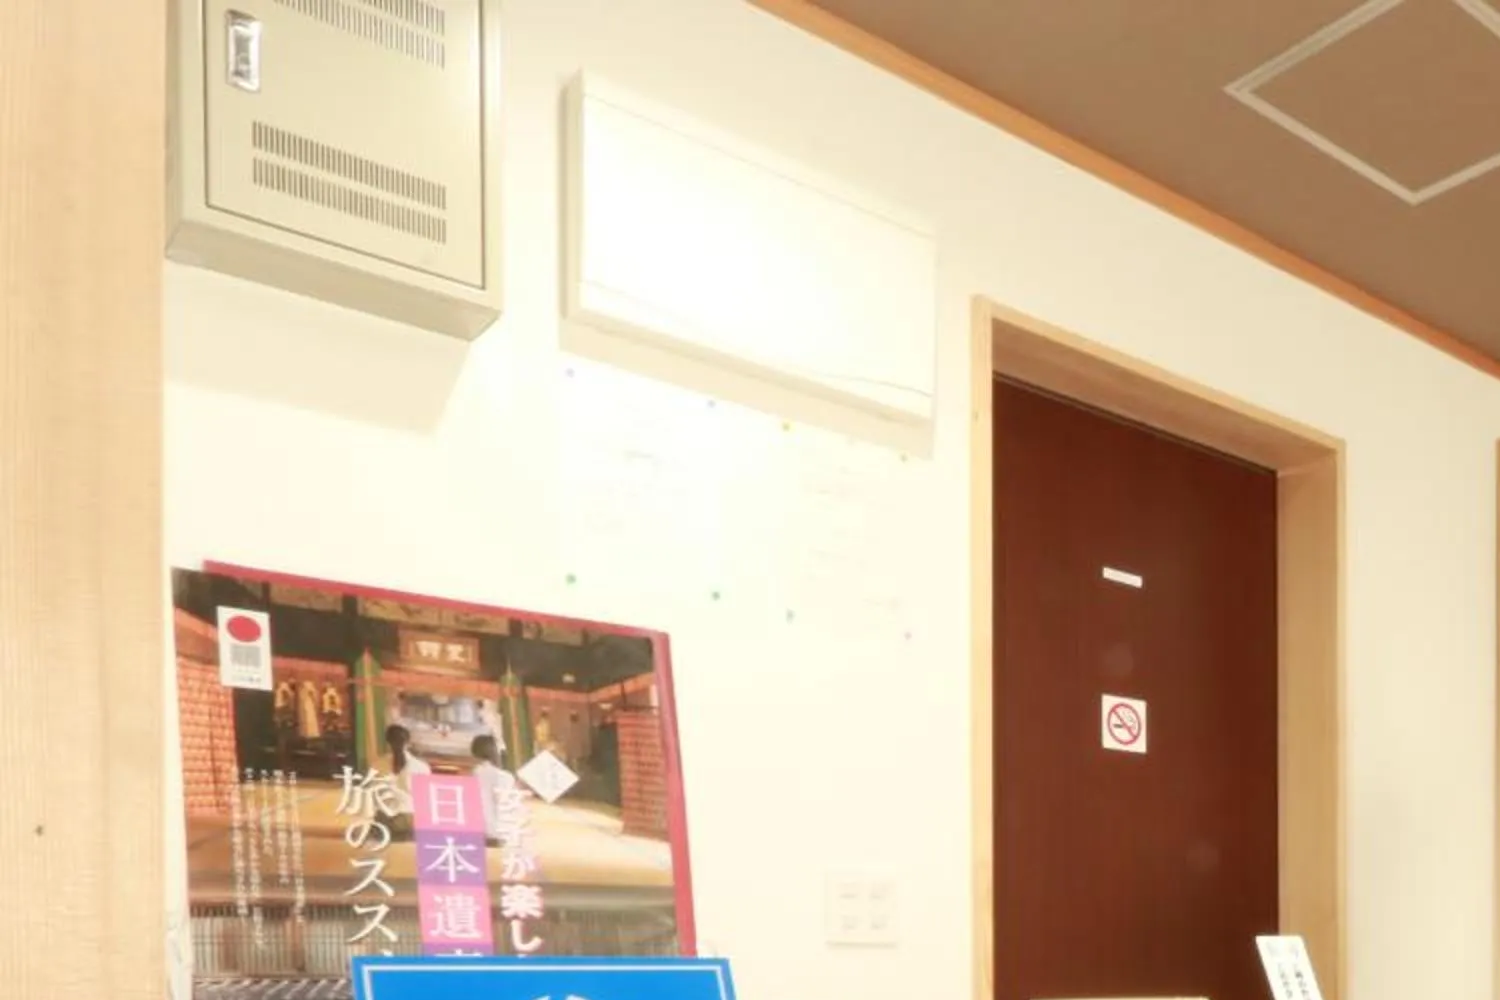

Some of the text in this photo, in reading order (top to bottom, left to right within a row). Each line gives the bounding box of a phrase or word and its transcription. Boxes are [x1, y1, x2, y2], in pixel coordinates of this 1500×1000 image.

[332, 766, 402, 957] 旅のスス
[495, 787, 544, 957] 女子が楽し
